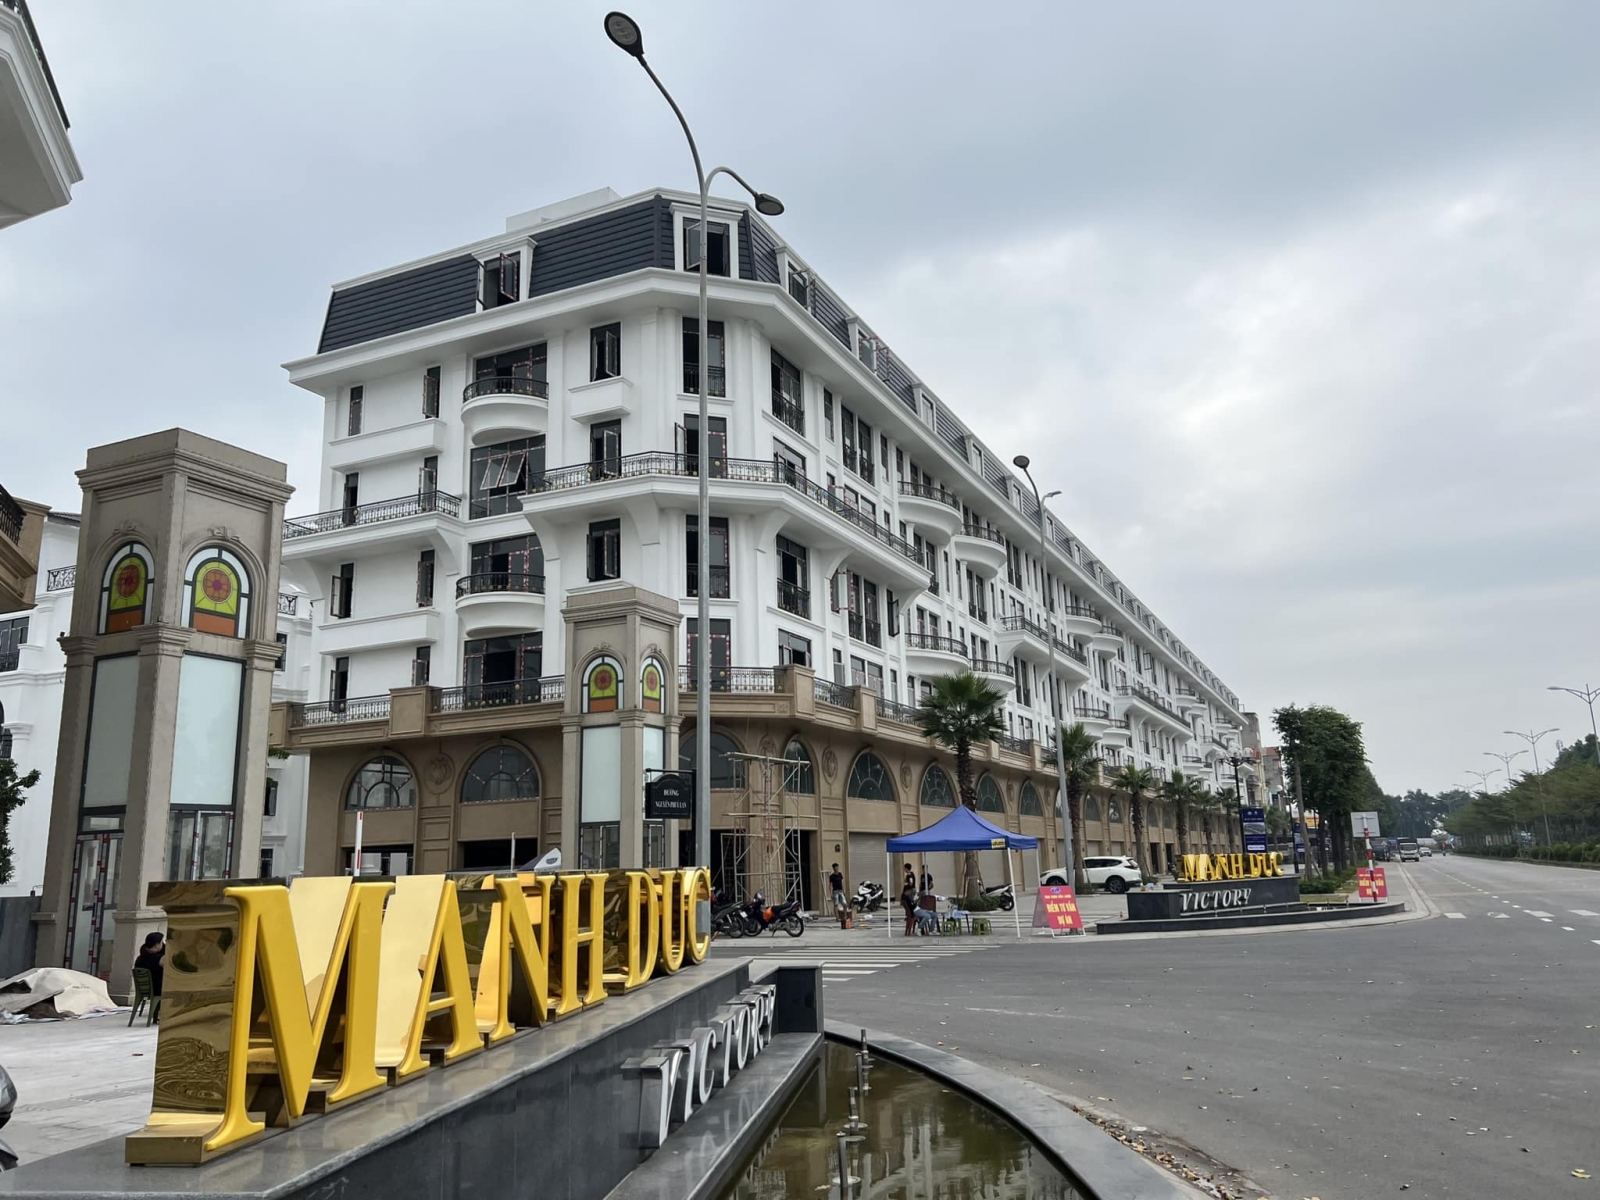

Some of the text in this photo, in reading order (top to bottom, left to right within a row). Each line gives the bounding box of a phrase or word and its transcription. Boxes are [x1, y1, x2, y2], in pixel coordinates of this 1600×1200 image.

[1180, 888, 1252, 912] VICTORY
[202, 868, 610, 1151] MANH
[640, 984, 777, 1150] VICTORY
